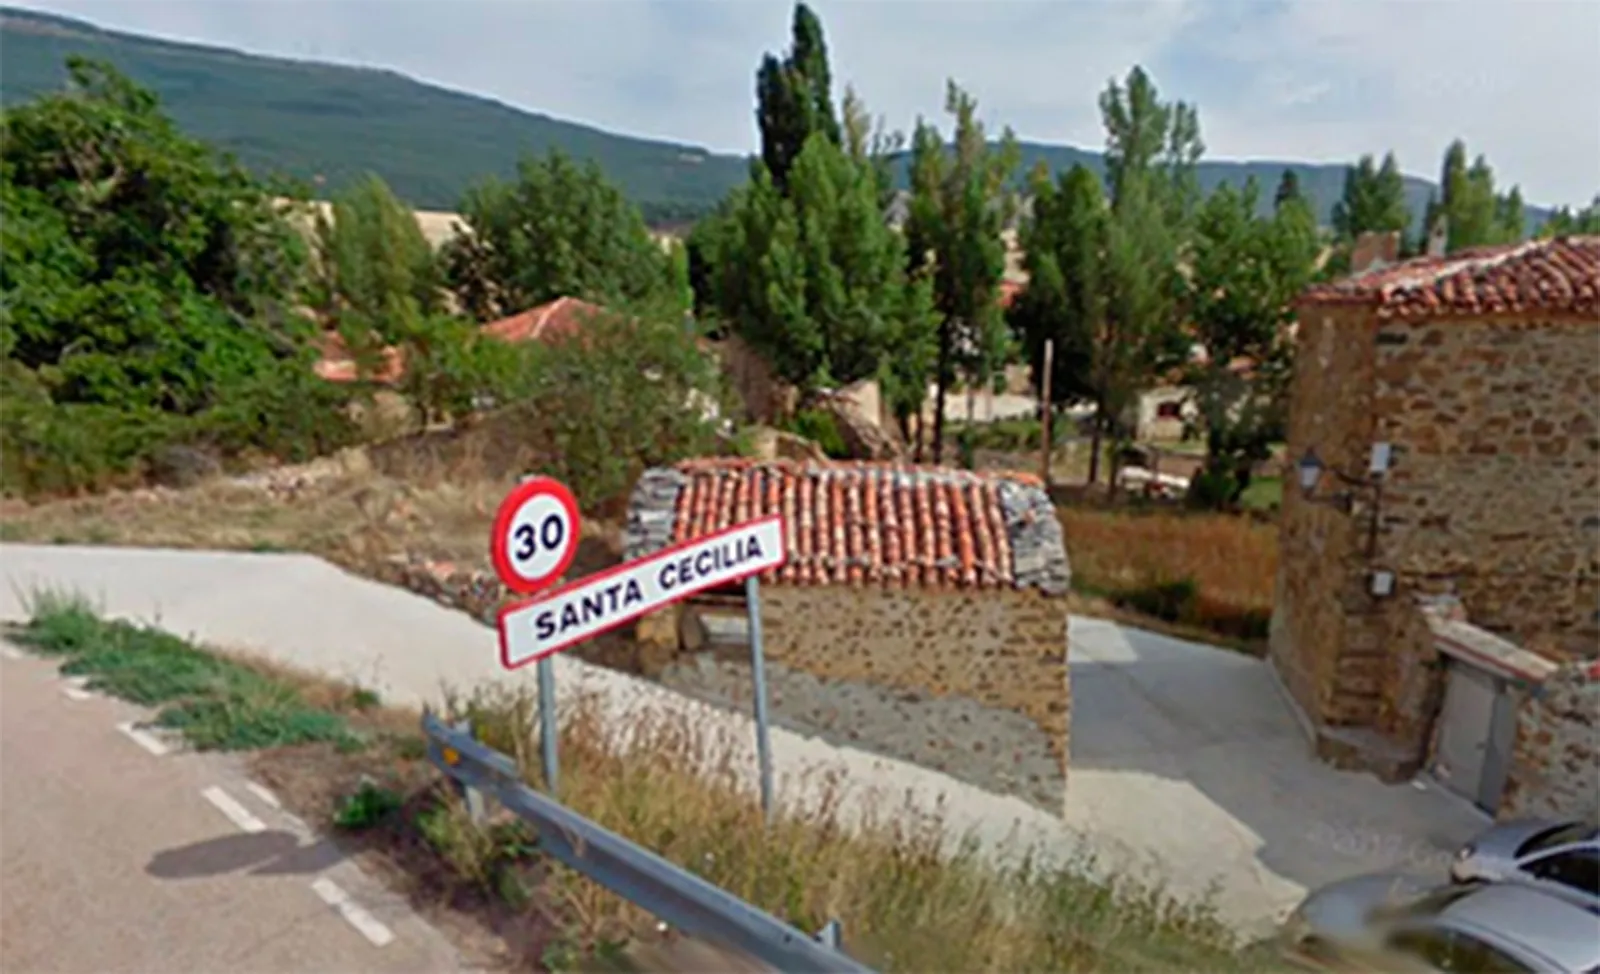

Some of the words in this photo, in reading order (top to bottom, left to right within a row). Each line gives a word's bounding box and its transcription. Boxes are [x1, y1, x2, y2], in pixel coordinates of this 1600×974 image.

[514, 513, 565, 562] 30
[534, 578, 645, 641] SANTA
[656, 534, 764, 591] CECILIA
